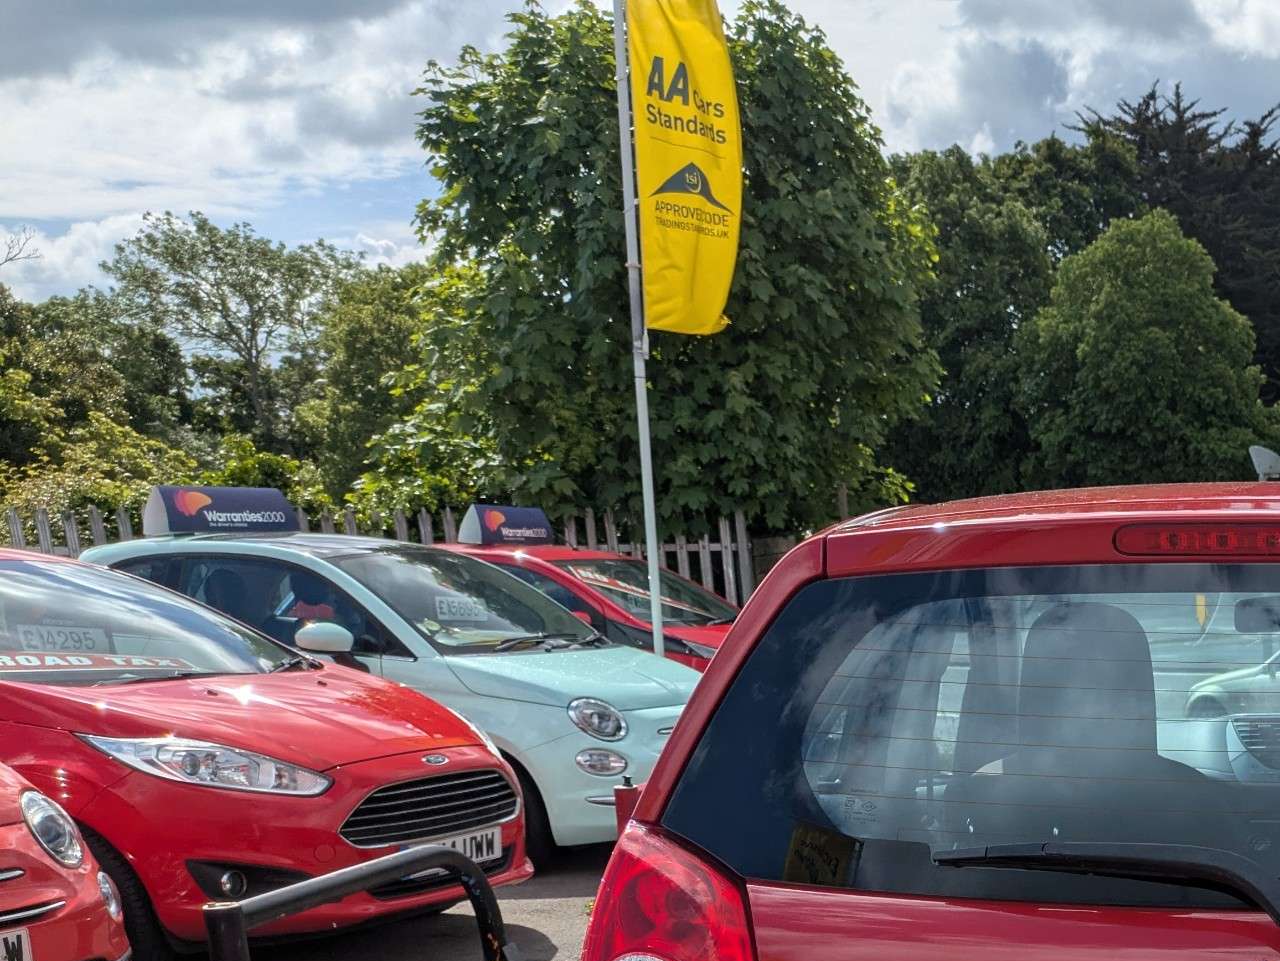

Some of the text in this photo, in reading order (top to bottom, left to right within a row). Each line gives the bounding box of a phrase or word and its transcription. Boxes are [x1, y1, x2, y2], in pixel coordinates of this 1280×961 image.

[647, 56, 724, 118] AA Cars
[203, 510, 285, 522] Warranties2000
